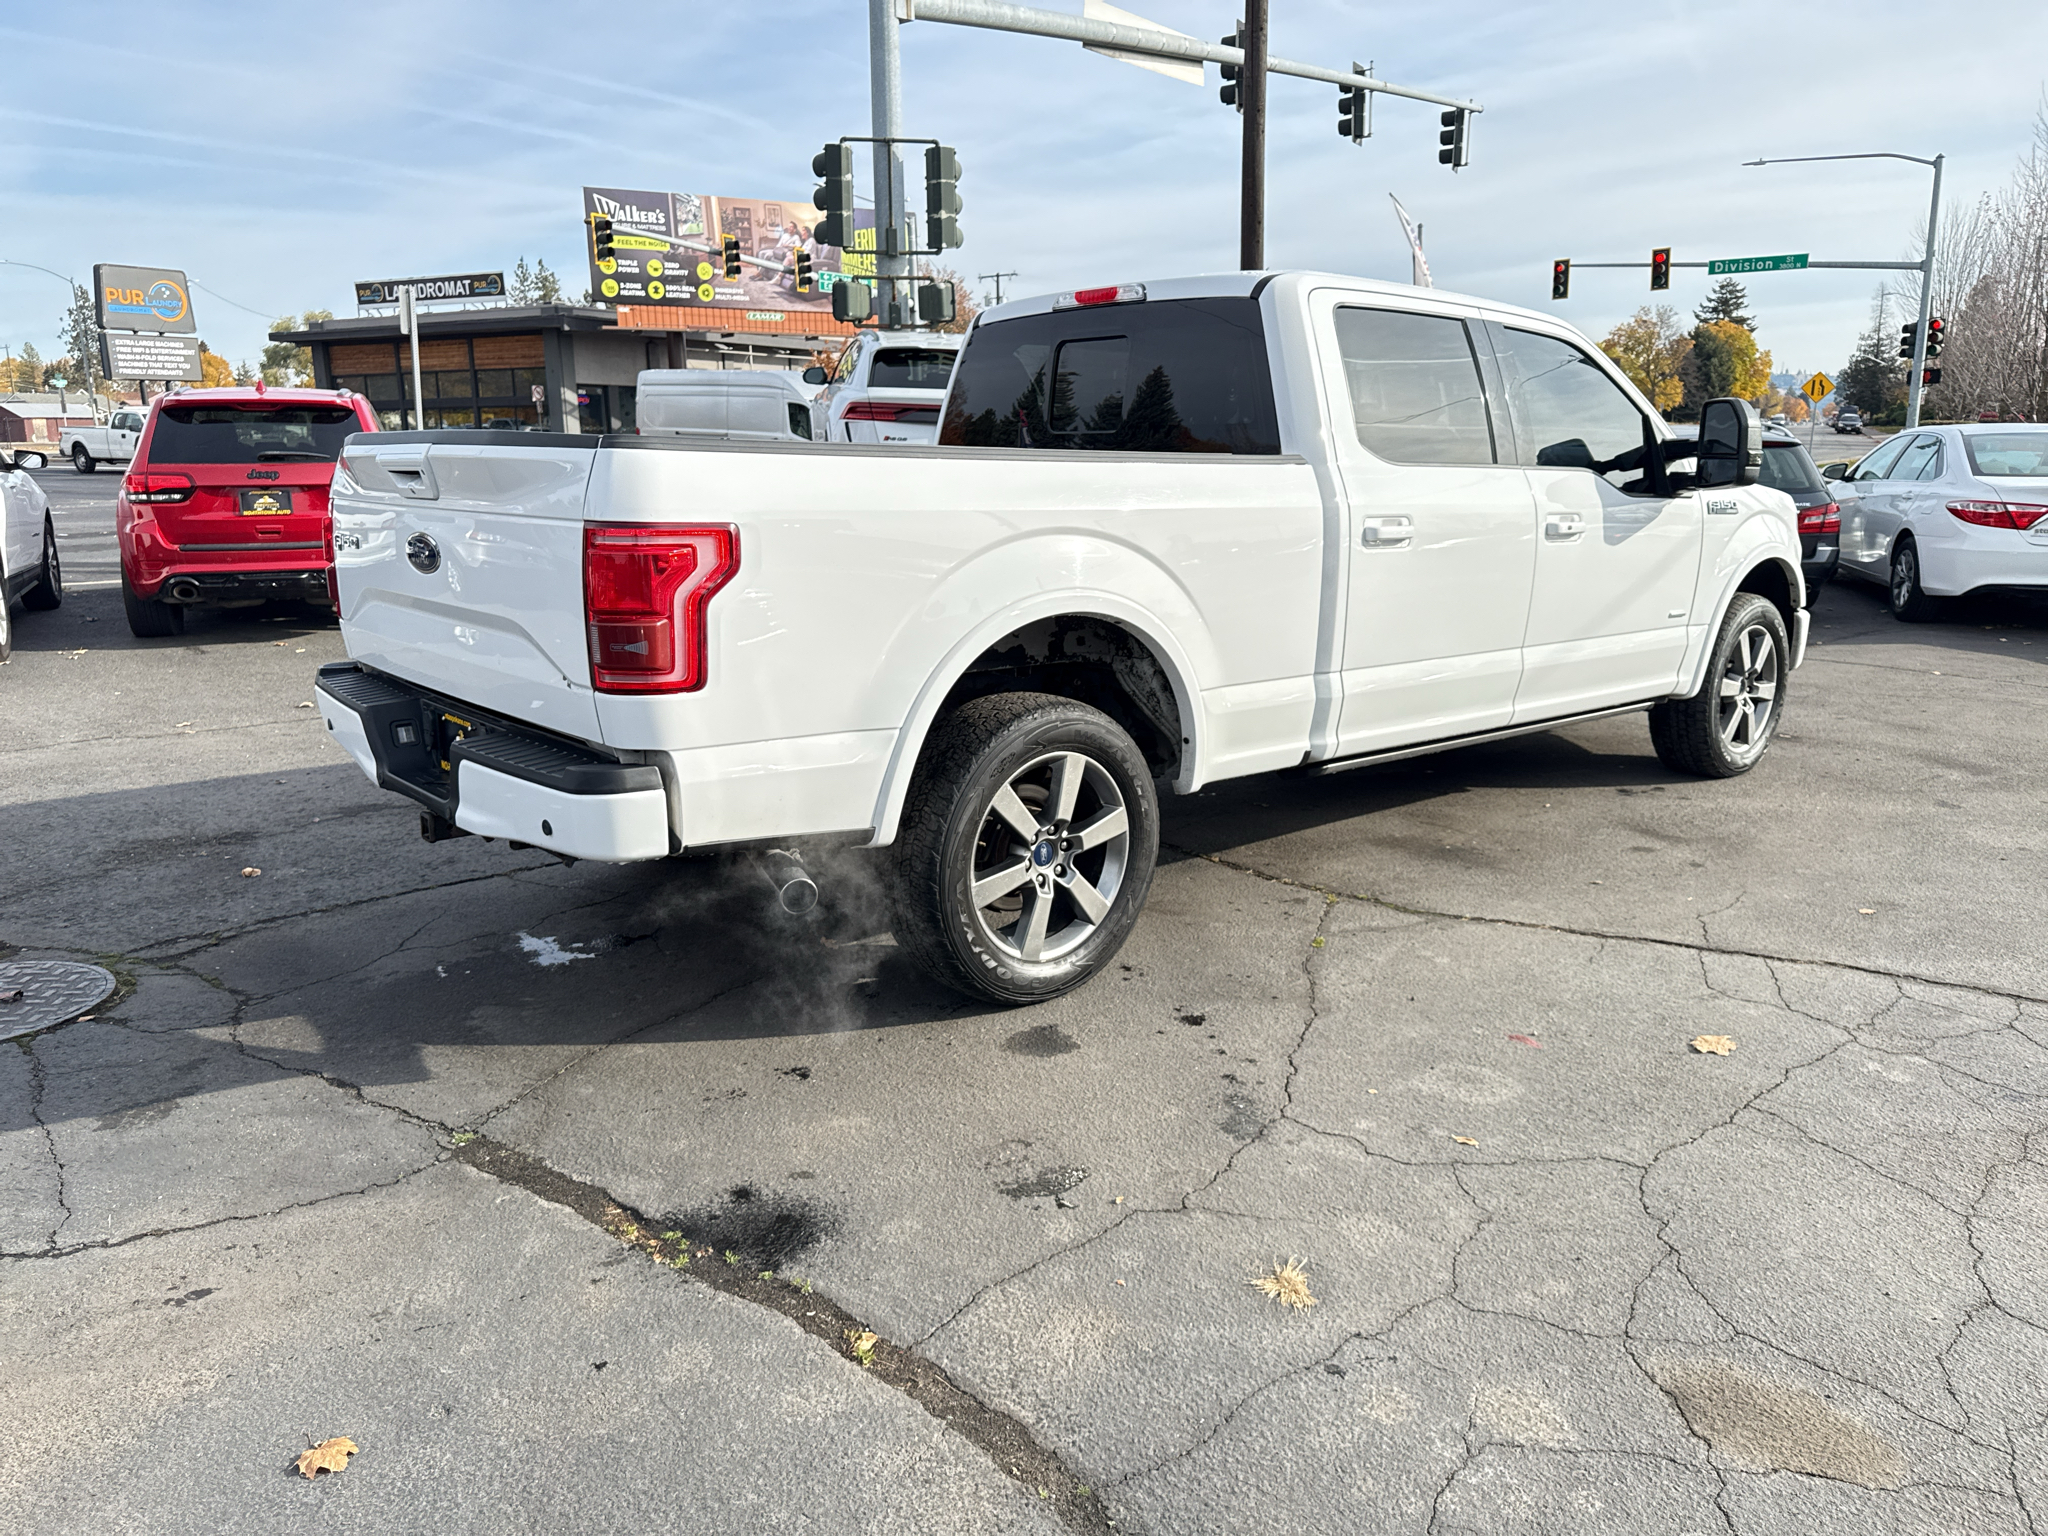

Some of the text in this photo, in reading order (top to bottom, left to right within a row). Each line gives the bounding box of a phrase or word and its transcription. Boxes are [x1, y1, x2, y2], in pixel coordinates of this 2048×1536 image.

[637, 224, 667, 232] MATTRESS
[634, 239, 647, 247] THE
[617, 259, 638, 267] TRIPLE
[664, 261, 680, 269] ZERO
[1714, 255, 1795, 273] Division St
[664, 269, 689, 277] GRAVITY
[474, 281, 487, 289] PUR
[359, 289, 371, 297] PUR
[384, 280, 471, 300] LADROMAT
[619, 289, 646, 297] HEATING
[714, 287, 745, 295] IMMERSIVE
[105, 287, 145, 305] PUR
[145, 296, 183, 308] LAUNDRY
[109, 305, 151, 314] LAUNDROMAT
[749, 312, 782, 321] LAMAR
[157, 354, 184, 362] SERVICES
[147, 368, 184, 376] ATTENDANTS
[246, 468, 280, 481] Jeep
